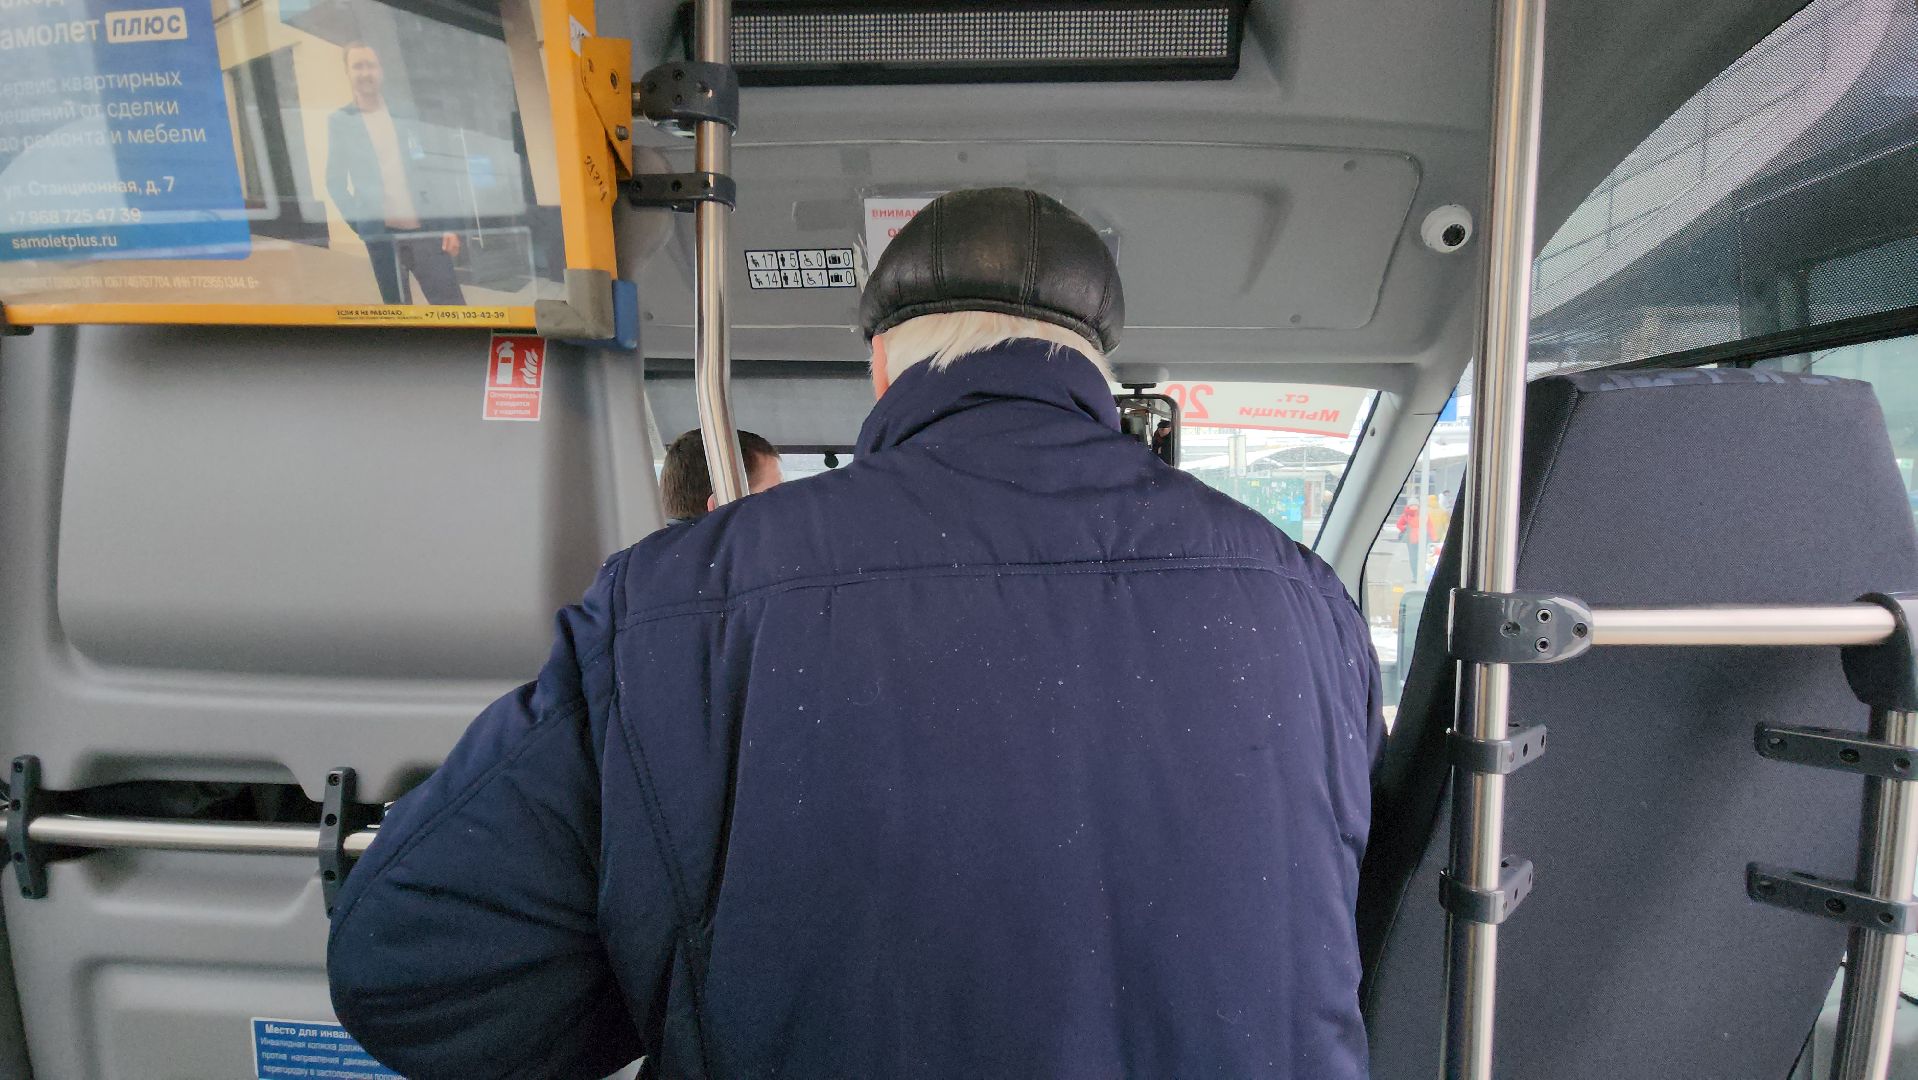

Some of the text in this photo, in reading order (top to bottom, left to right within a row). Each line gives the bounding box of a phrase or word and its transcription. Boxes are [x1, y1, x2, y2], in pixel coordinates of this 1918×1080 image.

[0, 19, 100, 50] амолет
[0, 70, 183, 98] ервис квартирных
[80, 103, 101, 119] от
[107, 99, 180, 120] сделки
[23, 129, 105, 152] ремонта
[111, 130, 122, 145] и
[127, 122, 207, 145] мебели
[28, 179, 142, 198] Станционная,
[145, 179, 161, 196] д.
[162, 175, 175, 193] 7
[9, 210, 26, 225] +7
[64, 209, 94, 224] 725
[95, 208, 116, 223] 47
[119, 207, 142, 222] 39
[11, 233, 118, 250] samoletplus.ru
[762, 251, 851, 268] 17 5 0 0
[765, 272, 778, 286] 14
[793, 272, 800, 285] 4
[845, 270, 853, 285] 0
[425, 311, 435, 319] +7
[437, 310, 460, 320] (495)
[462, 311, 505, 319] 103-42-39
[264, 1023, 352, 1039] Место для инвал
